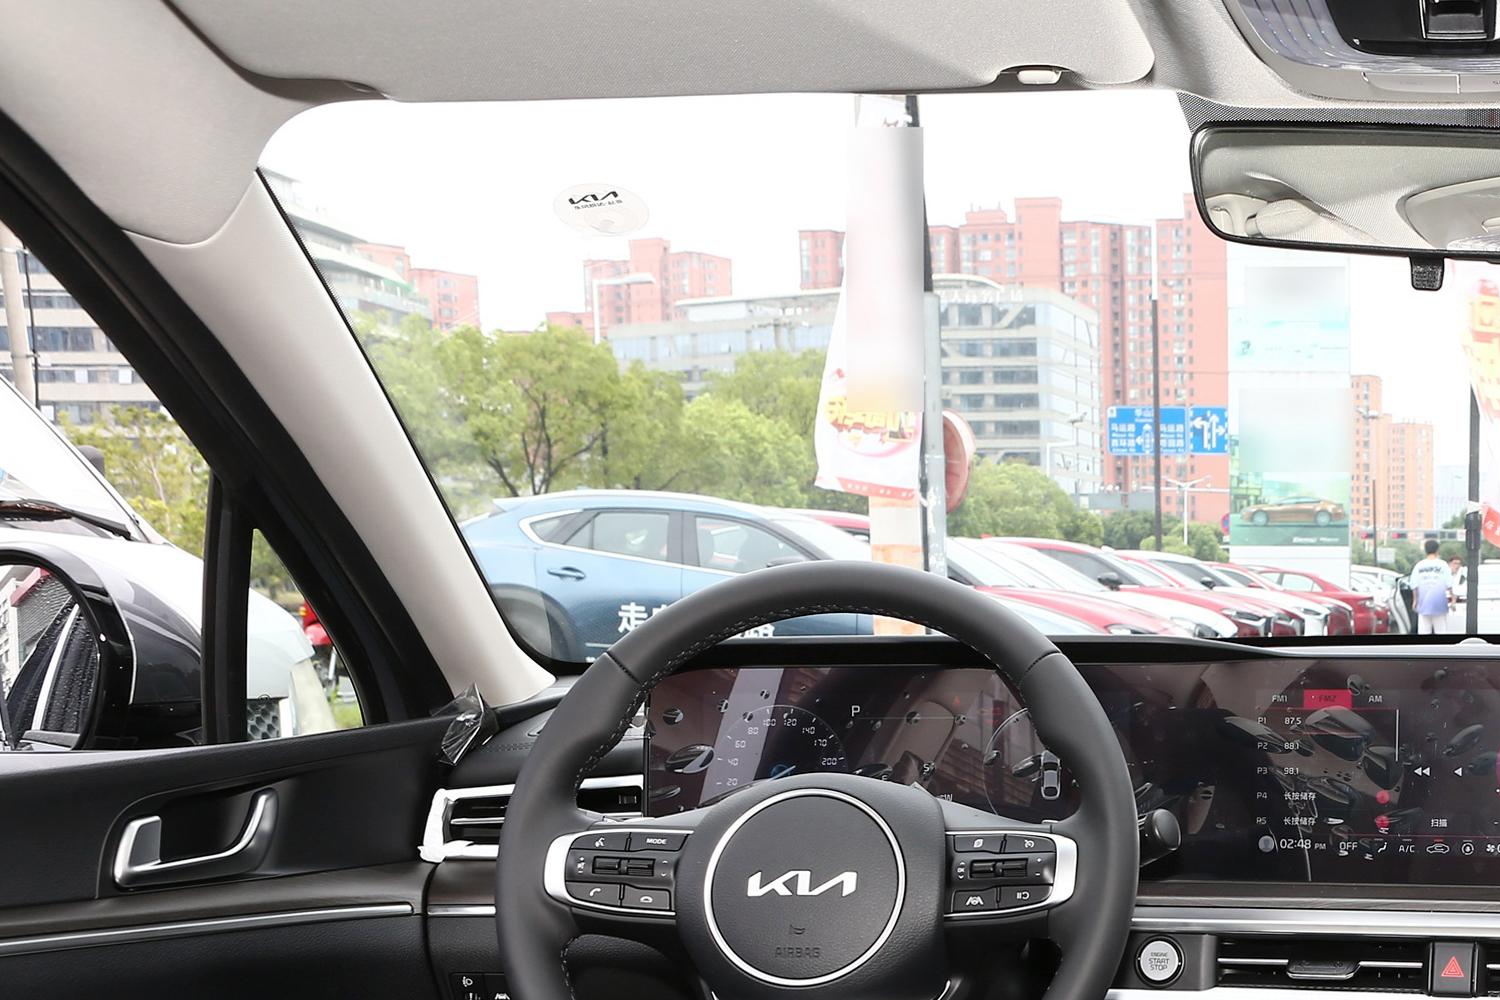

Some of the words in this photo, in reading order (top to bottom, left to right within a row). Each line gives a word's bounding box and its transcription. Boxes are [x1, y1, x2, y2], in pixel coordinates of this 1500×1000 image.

[1271, 695, 1288, 703] FM1
[1368, 695, 1383, 703] AM
[851, 705, 861, 717] P
[783, 718, 798, 727] 120
[1284, 716, 1302, 725] 87.5
[801, 726, 816, 735] 140
[734, 740, 747, 749] 60
[814, 738, 828, 748] 170
[821, 757, 838, 766] 200
[726, 779, 739, 787] 20
[1256, 791, 1268, 800] P4
[1430, 818, 1448, 828] 扫描
[1279, 838, 1312, 850] 02:48
[1339, 841, 1359, 851] OFF
[1398, 844, 1416, 853] A/C
[747, 869, 857, 897] KIA
[774, 946, 821, 958] AIRBAG
